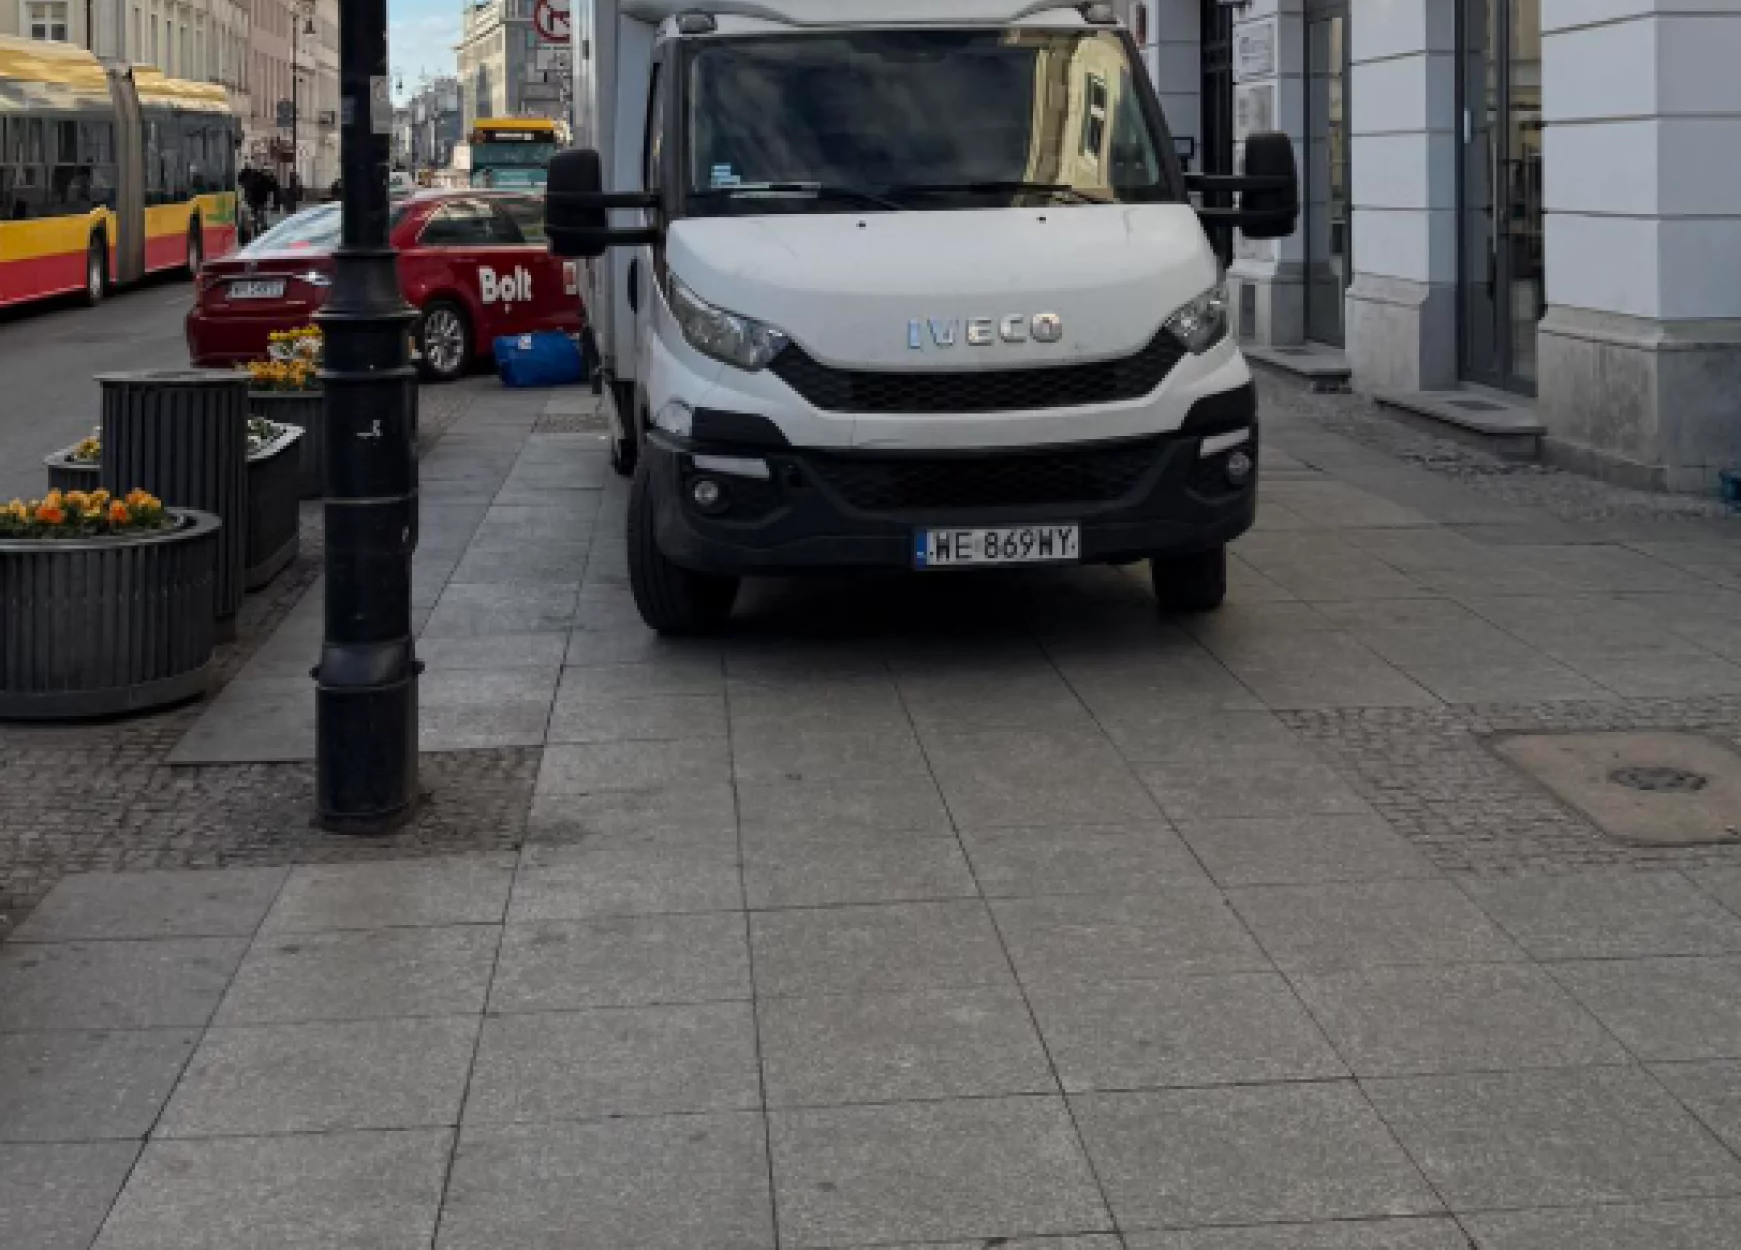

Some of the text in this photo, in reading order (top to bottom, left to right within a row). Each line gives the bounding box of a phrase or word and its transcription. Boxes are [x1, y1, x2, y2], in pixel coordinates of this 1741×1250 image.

[477, 265, 533, 314] Bolt
[907, 313, 1063, 350] IVECO
[935, 527, 1073, 562] WE 869WY
